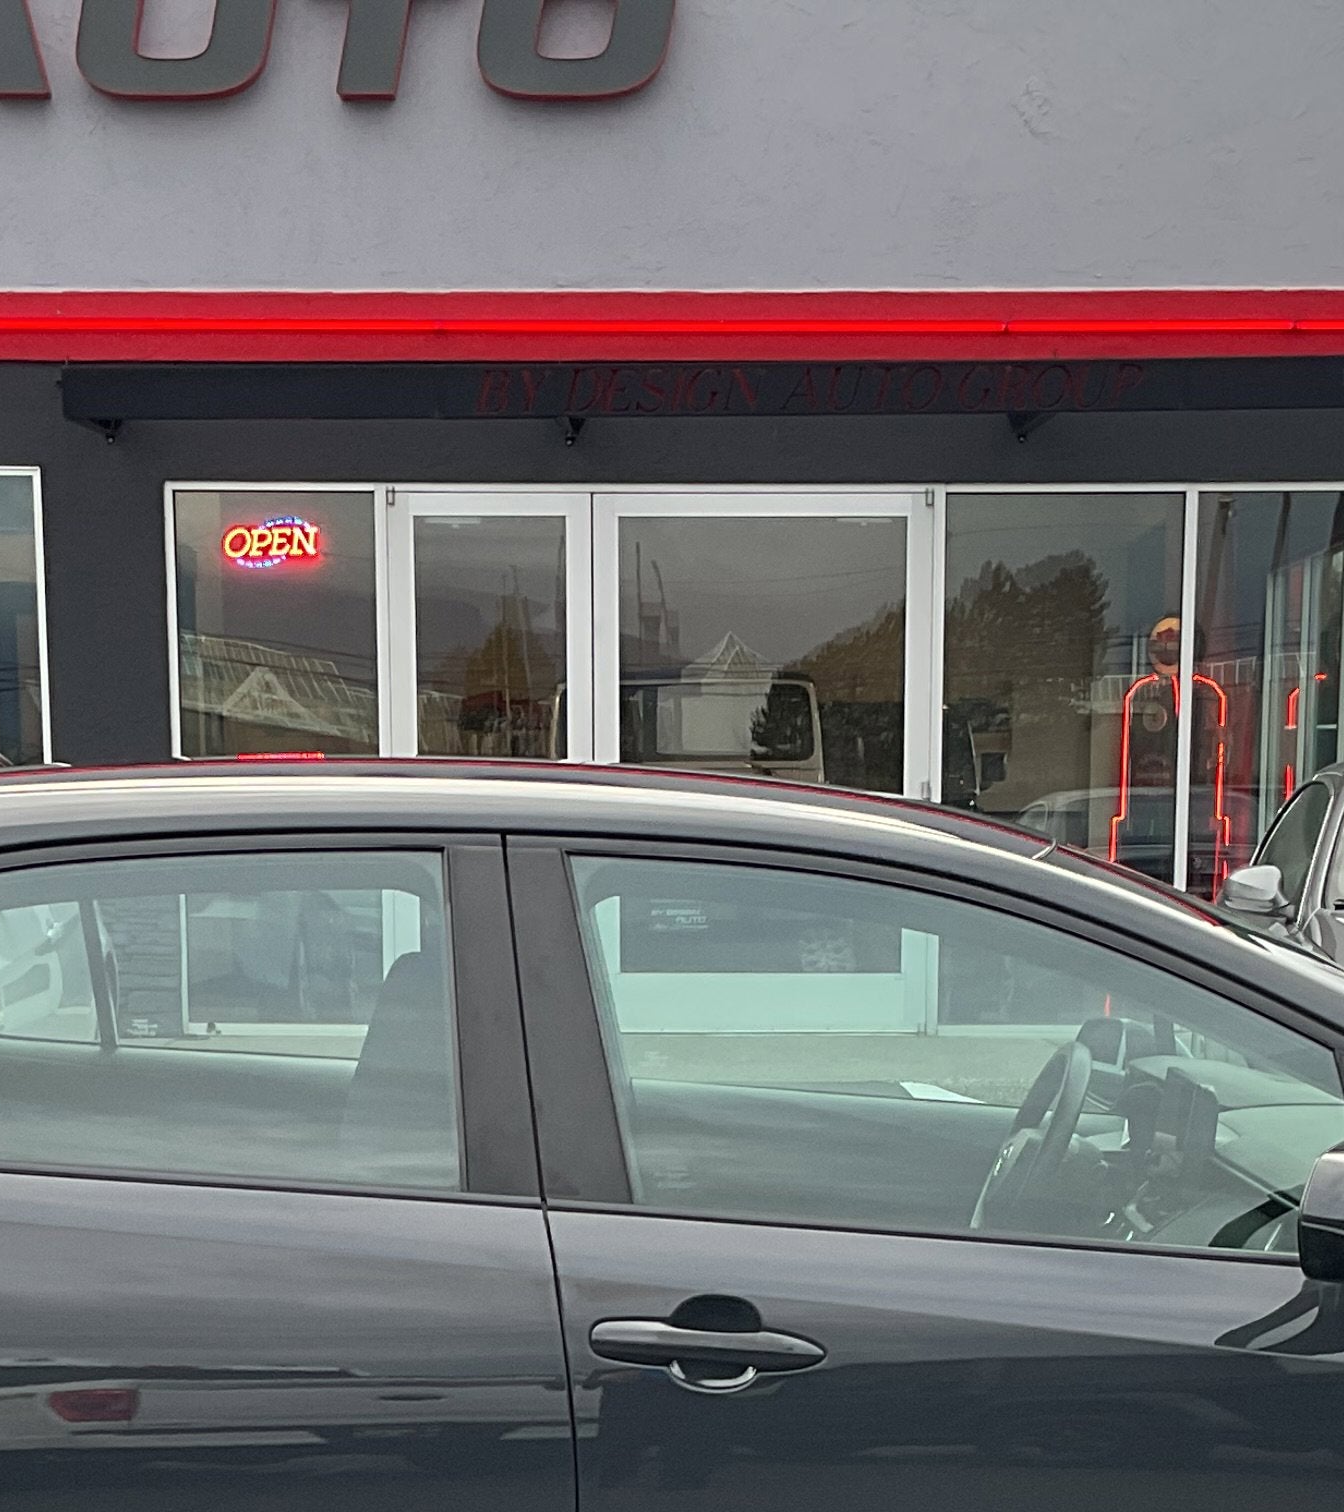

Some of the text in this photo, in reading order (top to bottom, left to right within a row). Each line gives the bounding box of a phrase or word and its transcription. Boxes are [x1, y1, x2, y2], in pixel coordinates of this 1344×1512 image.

[475, 363, 1145, 415] BY DESIGN AUTO GROUP
[222, 526, 319, 558] OPEN
